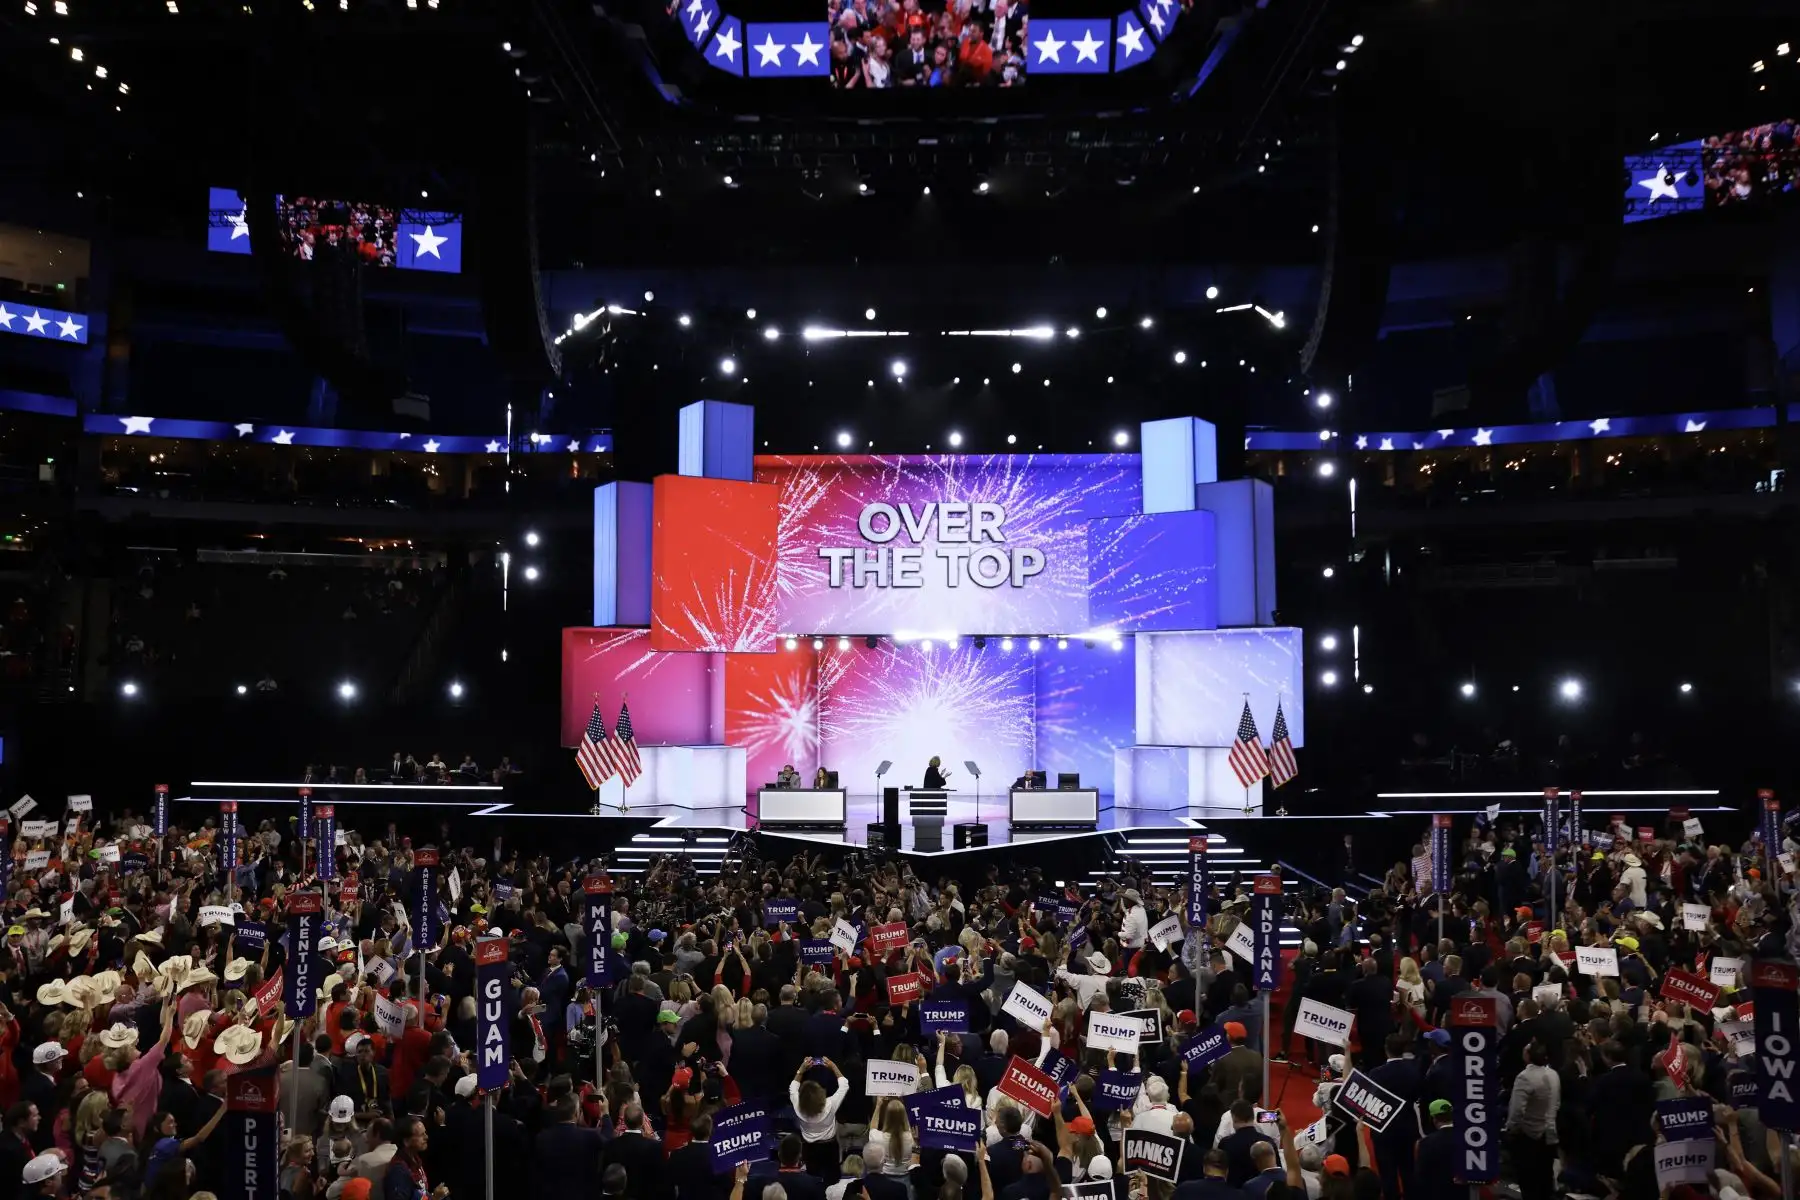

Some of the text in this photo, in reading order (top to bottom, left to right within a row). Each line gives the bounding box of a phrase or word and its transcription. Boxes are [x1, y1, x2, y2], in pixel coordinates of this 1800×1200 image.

[858, 502, 1006, 544] OVER
[819, 546, 1046, 588] THE TOP
[14, 799, 31, 814] TRUMP
[28, 856, 47, 864] TRUMP
[124, 859, 147, 869] TRUMP
[495, 883, 512, 892] TRUMP
[1192, 853, 1202, 922] FLORIDA
[1038, 896, 1058, 905] TRUM
[203, 910, 232, 918] TRUMP
[767, 906, 796, 914] TRUMP
[1685, 912, 1706, 920] TRUMP
[238, 928, 265, 937] TRUMP
[591, 905, 605, 974] MAINE
[837, 928, 855, 944] TRUM
[874, 929, 905, 941] TRUMP
[1153, 924, 1178, 942] TRUMP
[1236, 931, 1254, 947] TRU
[1260, 897, 1273, 983] INDIANA
[296, 916, 311, 1011] KENTUCKY
[1580, 955, 1613, 965] TRUMP
[1713, 966, 1737, 974] TRUMP
[260, 975, 283, 1004] TRUMP
[1669, 976, 1713, 1000] TRUMP
[1014, 992, 1048, 1017] TRUMP
[376, 1004, 402, 1025] TRUMP
[485, 978, 503, 1068] GUAM
[924, 1011, 965, 1020] TRUMP
[1303, 1010, 1347, 1031] TRUMP
[1093, 1024, 1136, 1038] TRUMP
[1730, 1030, 1755, 1041] TRU
[1184, 1034, 1221, 1059] TRUMP
[1761, 1012, 1796, 1103] IOWA
[871, 1071, 915, 1083] TRUMP
[1050, 1057, 1067, 1080] UMP
[1011, 1067, 1055, 1100] TRUMP
[1732, 1083, 1758, 1094] TRUM
[1345, 1081, 1393, 1120] BANKS
[1462, 1031, 1488, 1171] OREGON
[925, 1116, 977, 1133] TRUMP
[1661, 1110, 1708, 1126] TRUMP
[713, 1131, 762, 1153] TRUMP
[244, 1118, 258, 1200] PUERT
[1127, 1139, 1174, 1167] BANKS
[1658, 1154, 1707, 1169] TRUMP
